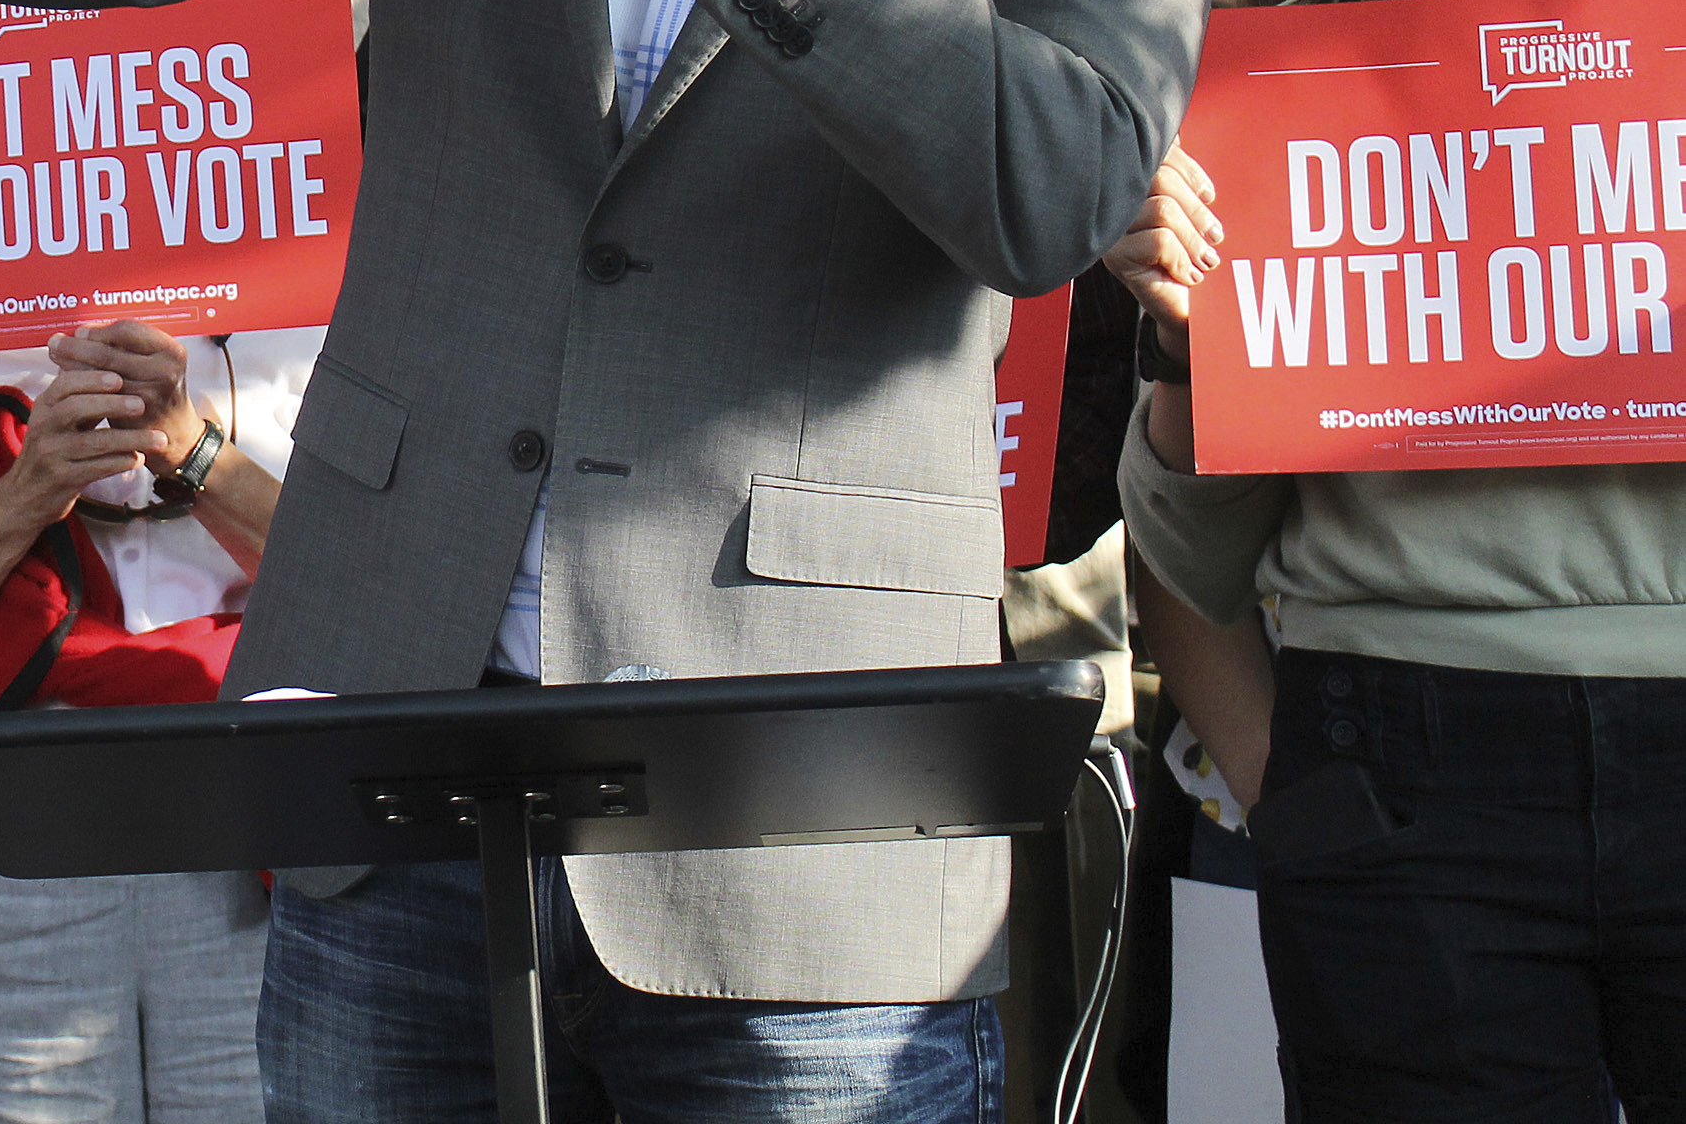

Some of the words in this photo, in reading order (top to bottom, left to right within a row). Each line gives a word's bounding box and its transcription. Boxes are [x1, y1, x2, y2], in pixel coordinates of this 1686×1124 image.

[48, 9, 101, 23] PROJECT
[1499, 31, 1601, 47] PROGRESSIVE
[1500, 39, 1632, 76] TURNOUT
[1568, 68, 1634, 81] PROJECT
[51, 43, 254, 153] MESS
[145, 139, 329, 247] VOTE
[1286, 126, 1545, 249] DON'T
[92, 282, 239, 306] turnoutpac.org
[1232, 250, 1465, 369] WITH
[1487, 240, 1673, 361] OUR
[1319, 400, 1606, 429] #DontMessWithOurVote
